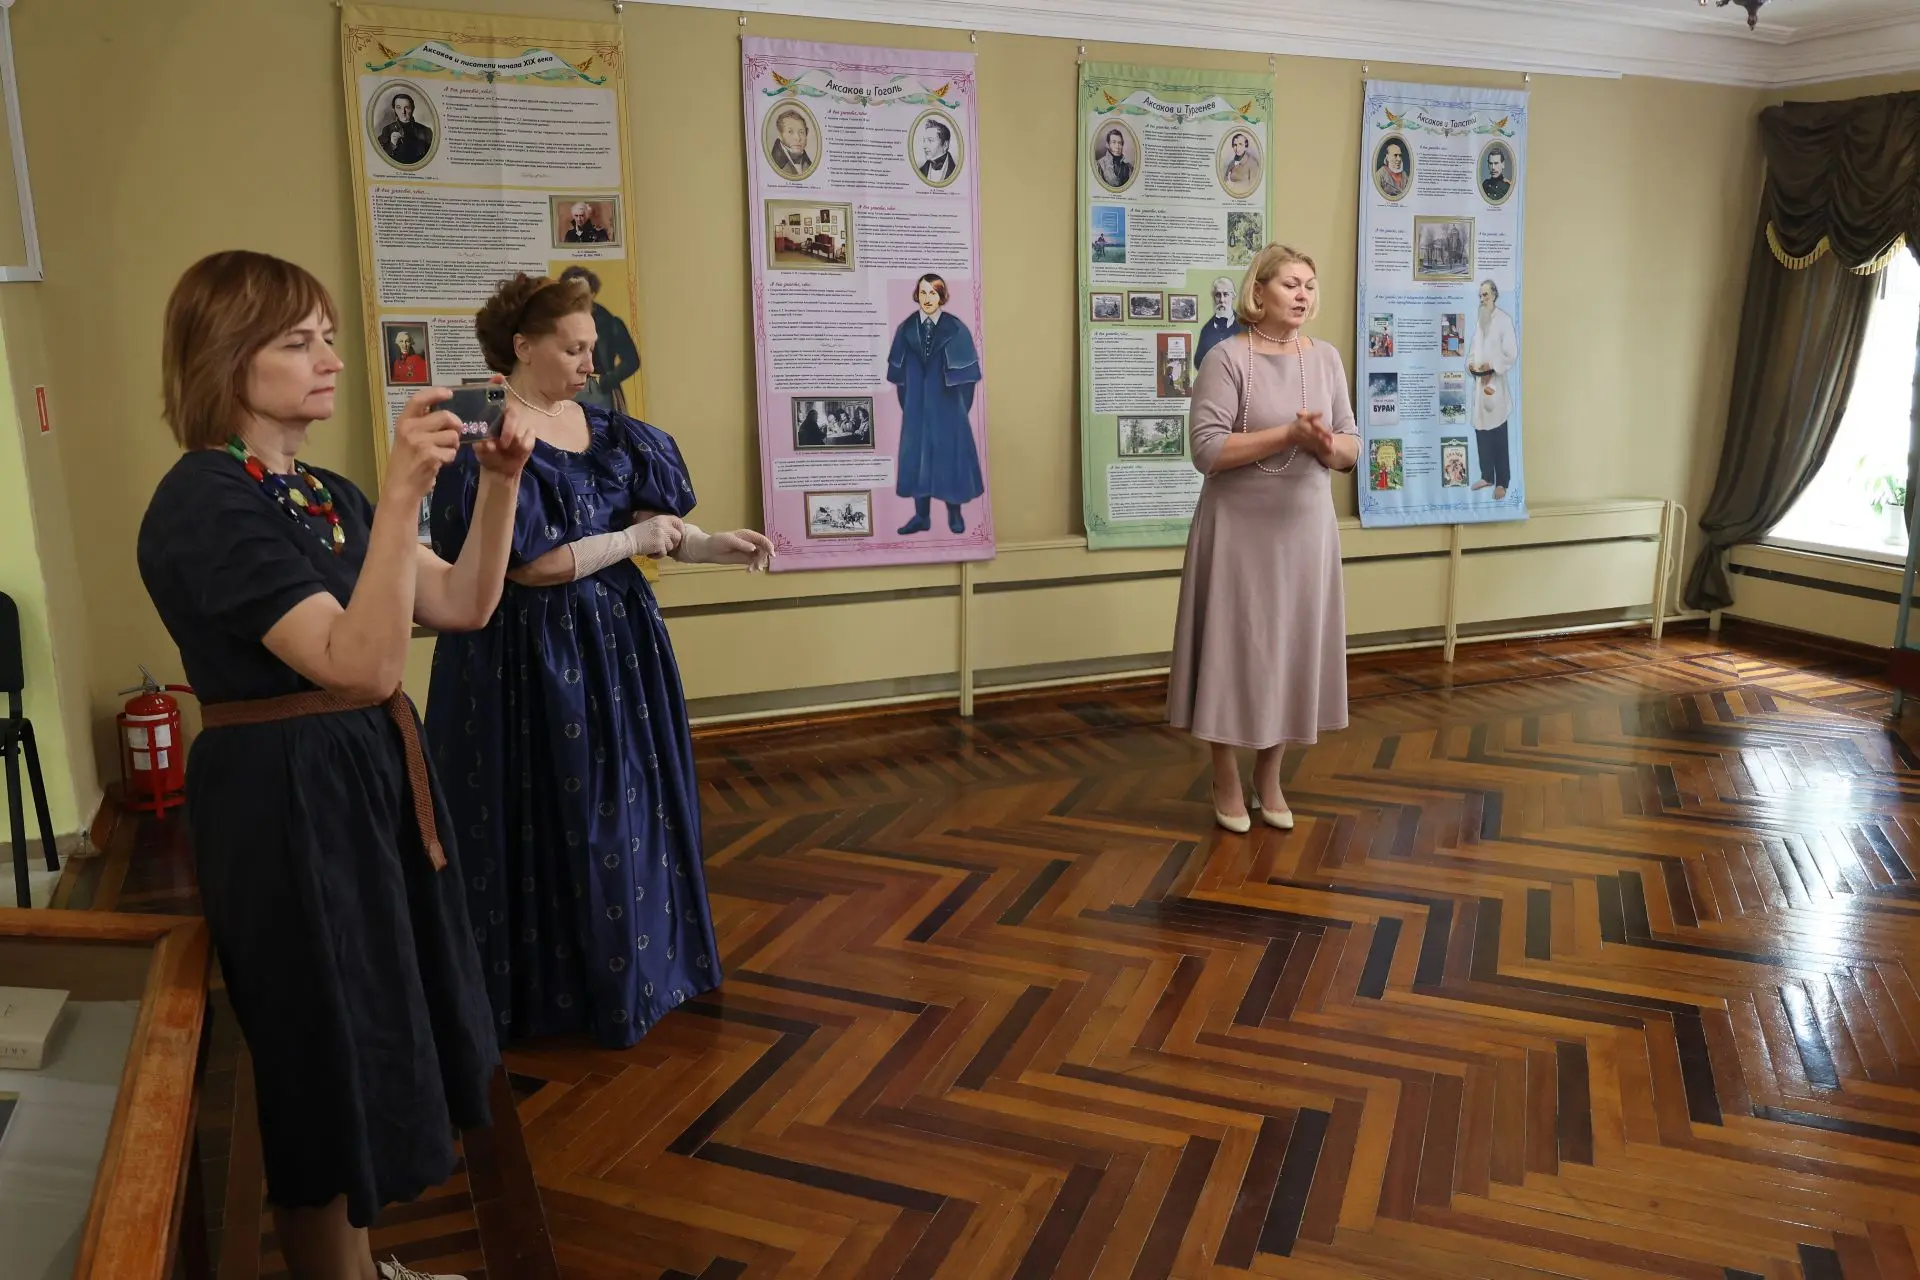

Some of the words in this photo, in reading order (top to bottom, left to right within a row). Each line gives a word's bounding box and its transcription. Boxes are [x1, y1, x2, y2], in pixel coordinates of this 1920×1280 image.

[422, 45, 453, 62] Аксаков
[460, 59, 496, 69] писатели
[497, 61, 522, 69] начала
[523, 57, 537, 67] XIX
[537, 55, 553, 63] века
[825, 79, 863, 95] Аксаков
[874, 85, 903, 97] Гоголь
[1143, 96, 1174, 114] Аксаков
[1184, 101, 1216, 117] Тургенев
[1416, 112, 1443, 127] Аксаков
[1373, 404, 1395, 413] БУРАН
